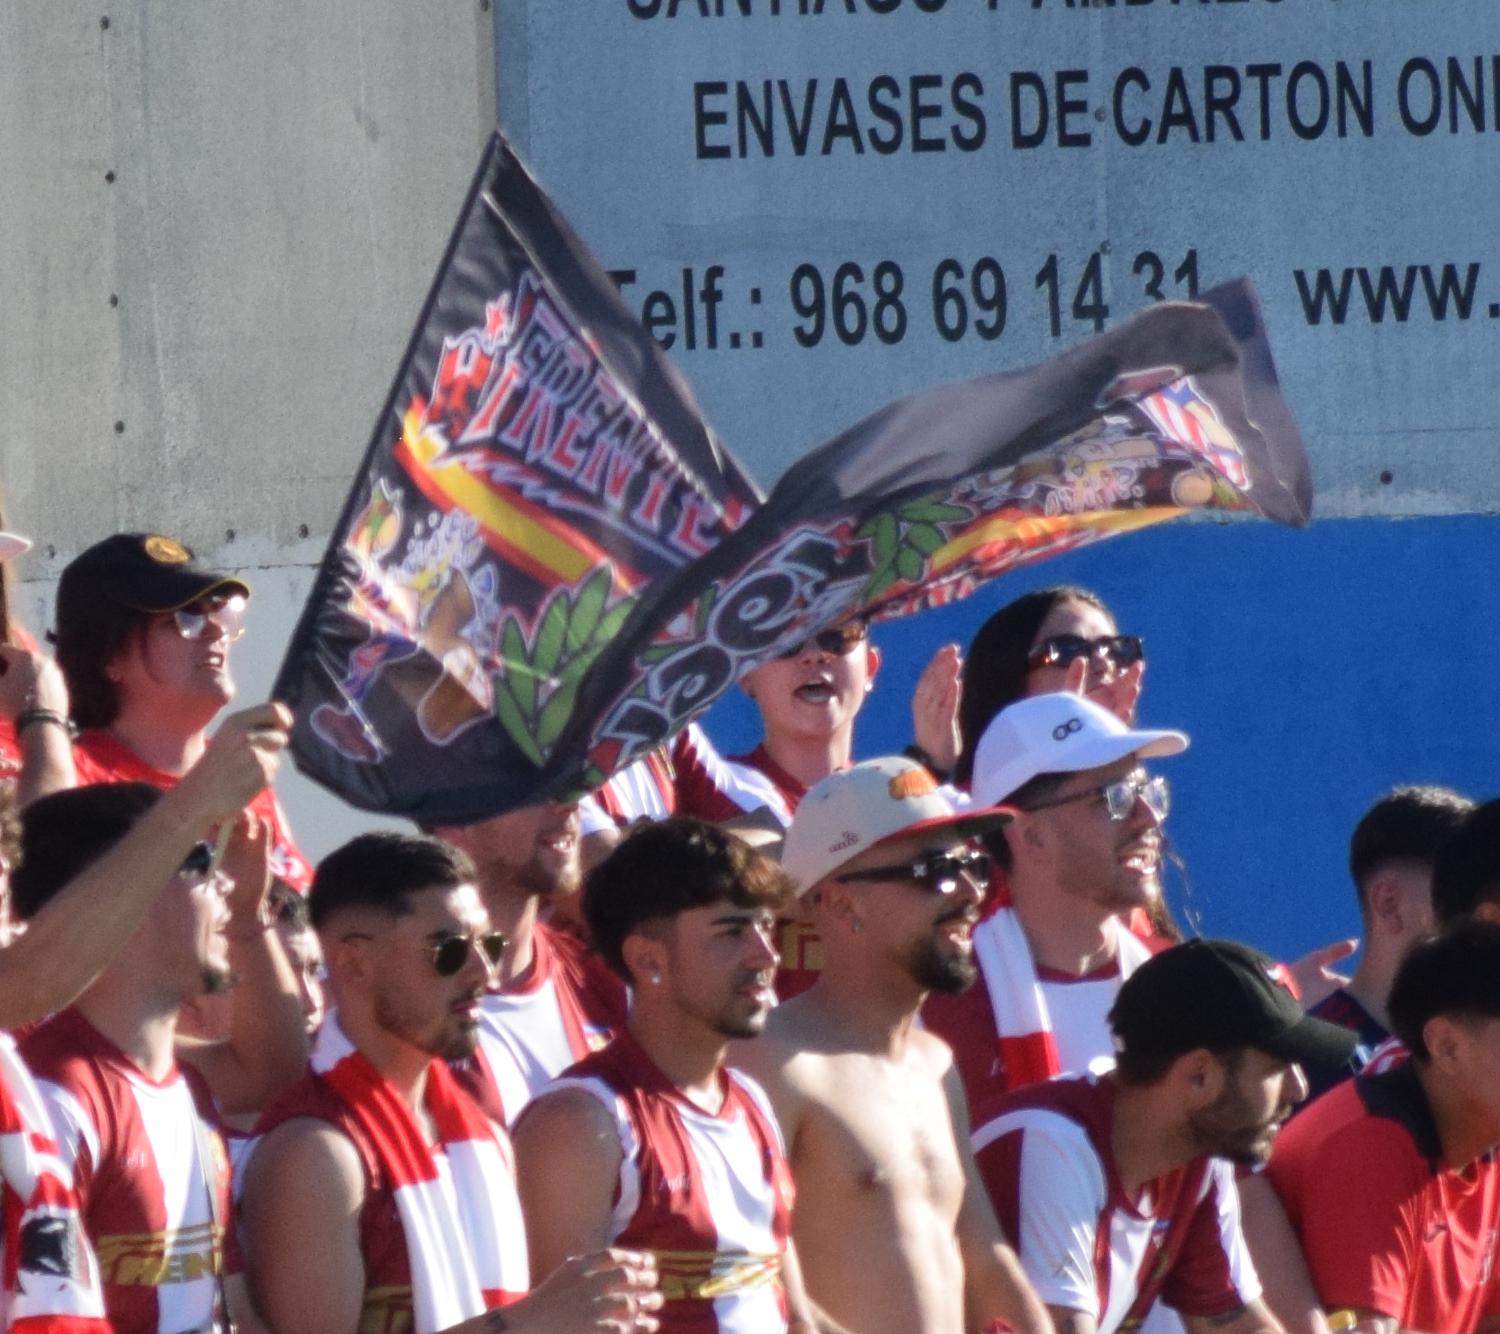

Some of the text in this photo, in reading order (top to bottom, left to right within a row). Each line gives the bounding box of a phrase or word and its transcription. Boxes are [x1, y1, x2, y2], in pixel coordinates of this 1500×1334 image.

[693, 71, 988, 160] ENVASES
[1010, 69, 1092, 150] DE
[1112, 58, 1374, 147] CARTON
[789, 260, 908, 348] 968
[931, 256, 1008, 343] 69
[1034, 252, 1110, 337] 14
[1131, 247, 1198, 303] 31
